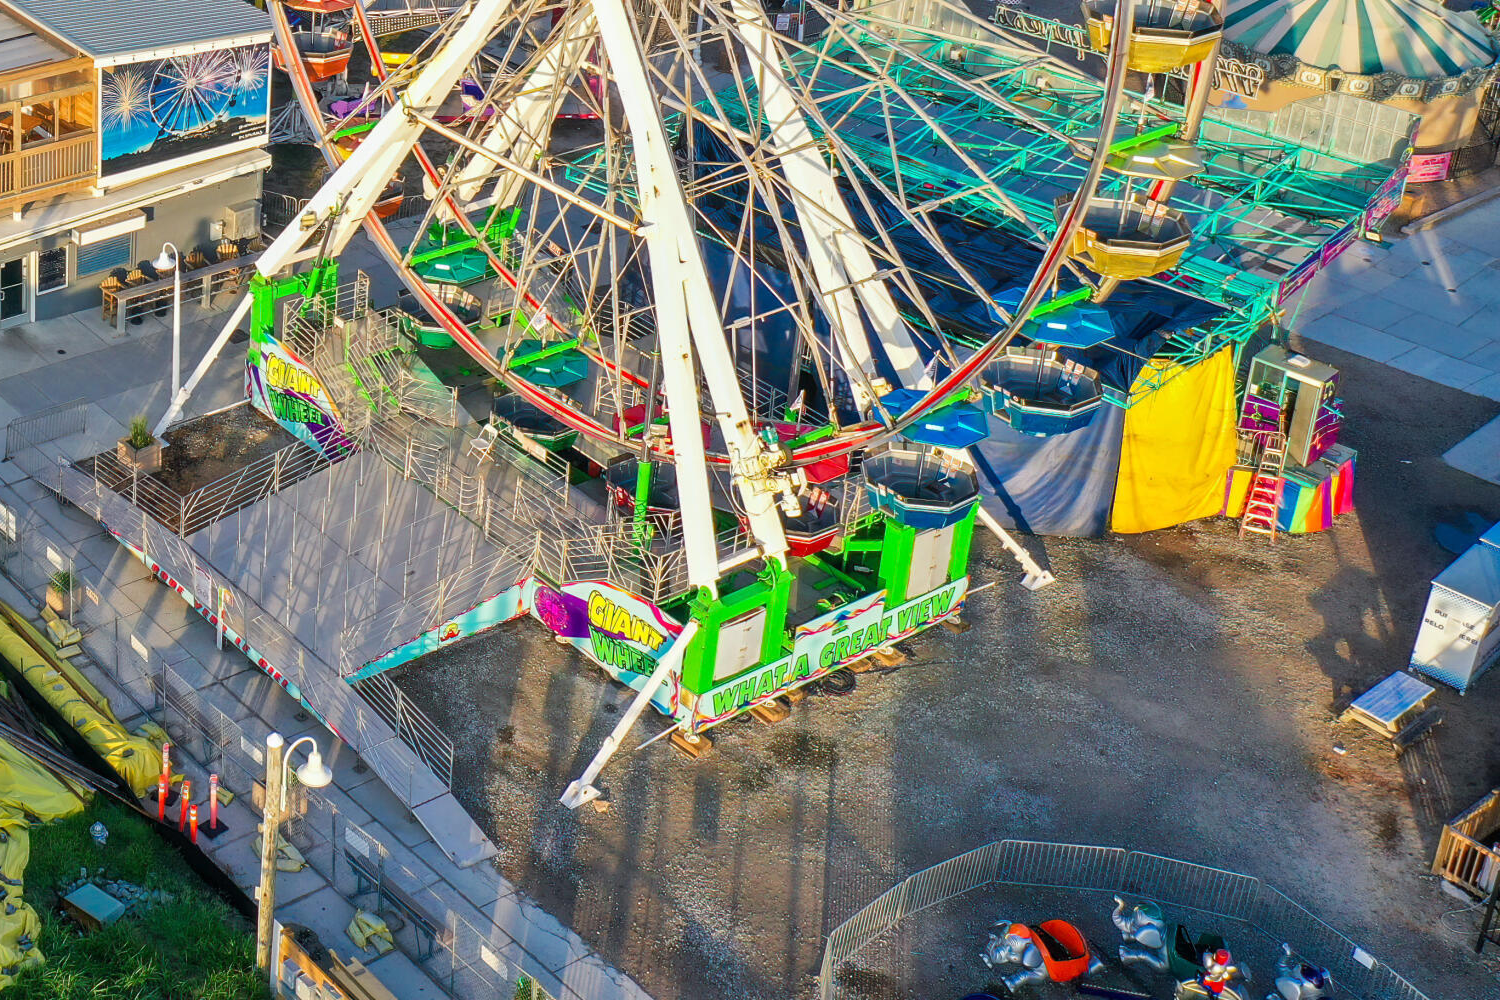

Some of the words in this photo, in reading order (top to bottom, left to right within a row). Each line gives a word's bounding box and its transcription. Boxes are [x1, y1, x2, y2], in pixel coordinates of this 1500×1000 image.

[266, 352, 321, 398] GIANT
[266, 384, 326, 427] WHEEL
[588, 590, 665, 652] GIANT
[713, 662, 788, 717] WHAT
[789, 653, 810, 683] A
[819, 616, 893, 668] GREAT
[898, 587, 956, 634] VIEW
[588, 623, 668, 687] WHEE
